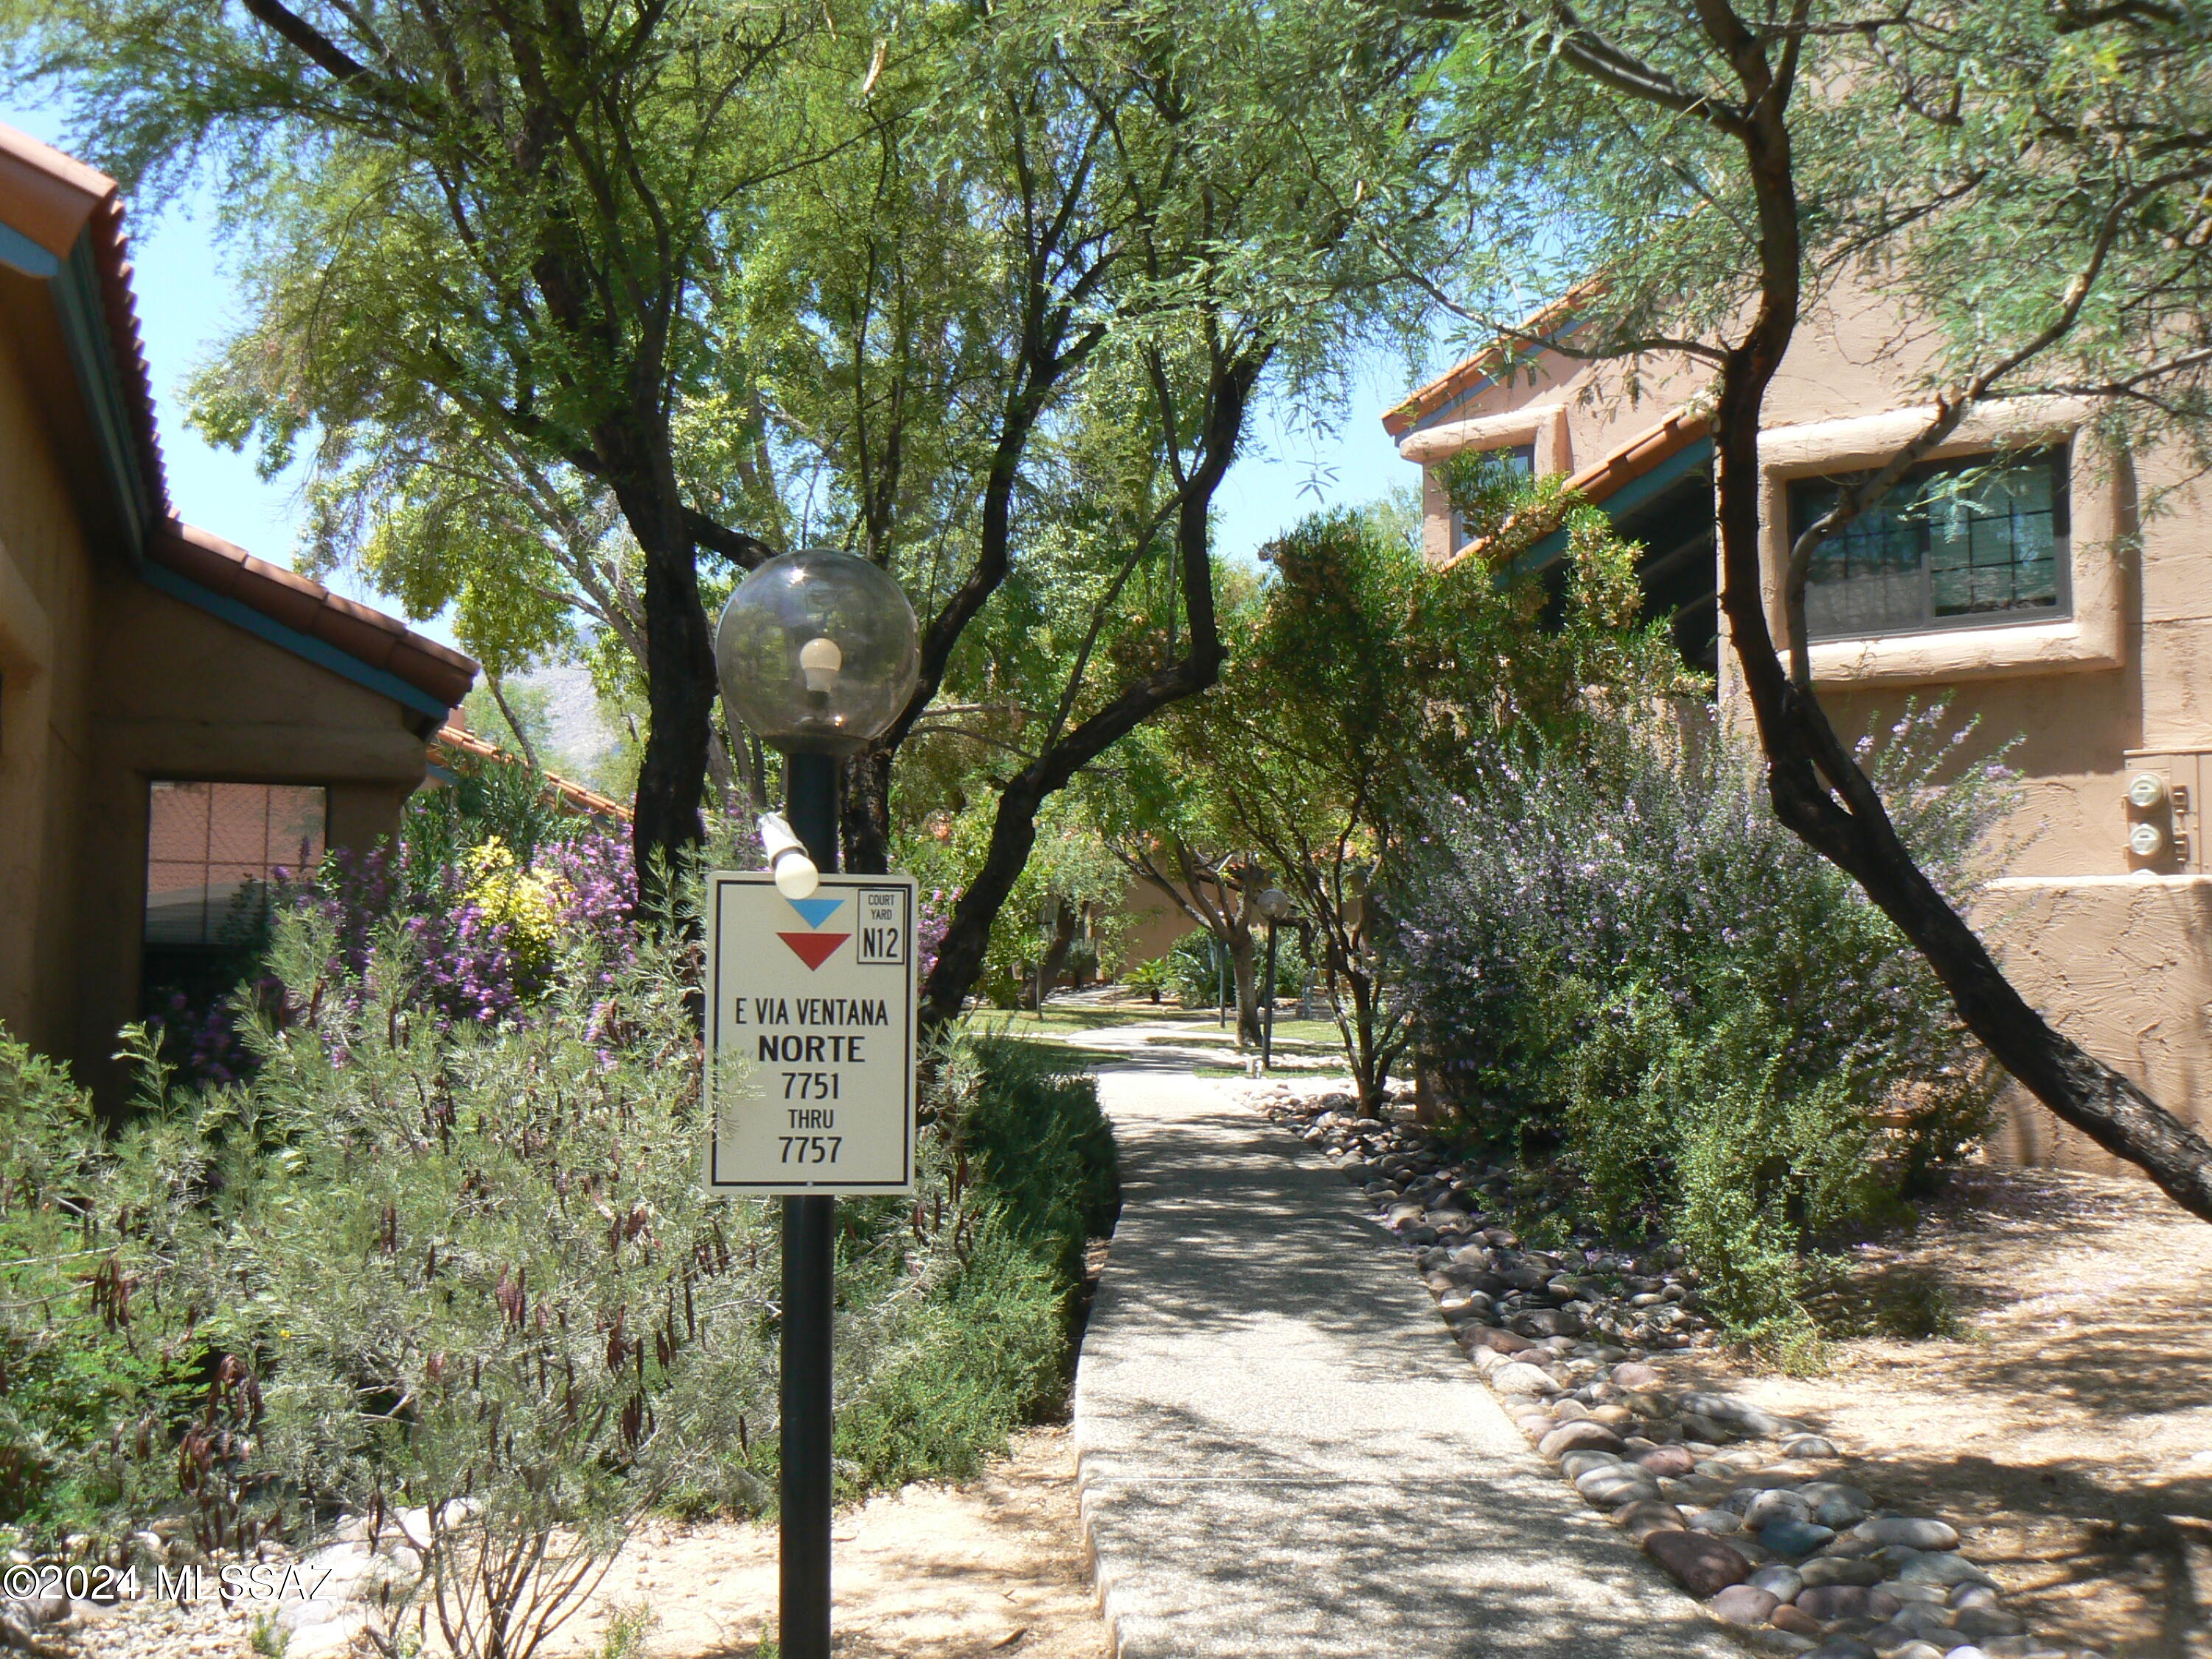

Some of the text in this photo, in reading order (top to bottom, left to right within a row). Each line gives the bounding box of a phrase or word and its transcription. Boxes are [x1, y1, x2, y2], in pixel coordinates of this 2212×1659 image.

[868, 894, 894, 906] COURT
[871, 908, 892, 921] YARD
[863, 928, 899, 958] N12
[735, 998, 888, 1026] E VIA VENTANA
[758, 1035, 866, 1062] NORTE
[781, 1072, 839, 1100] 7751
[788, 1109, 834, 1129] THRU
[778, 1136, 842, 1164] 7757
